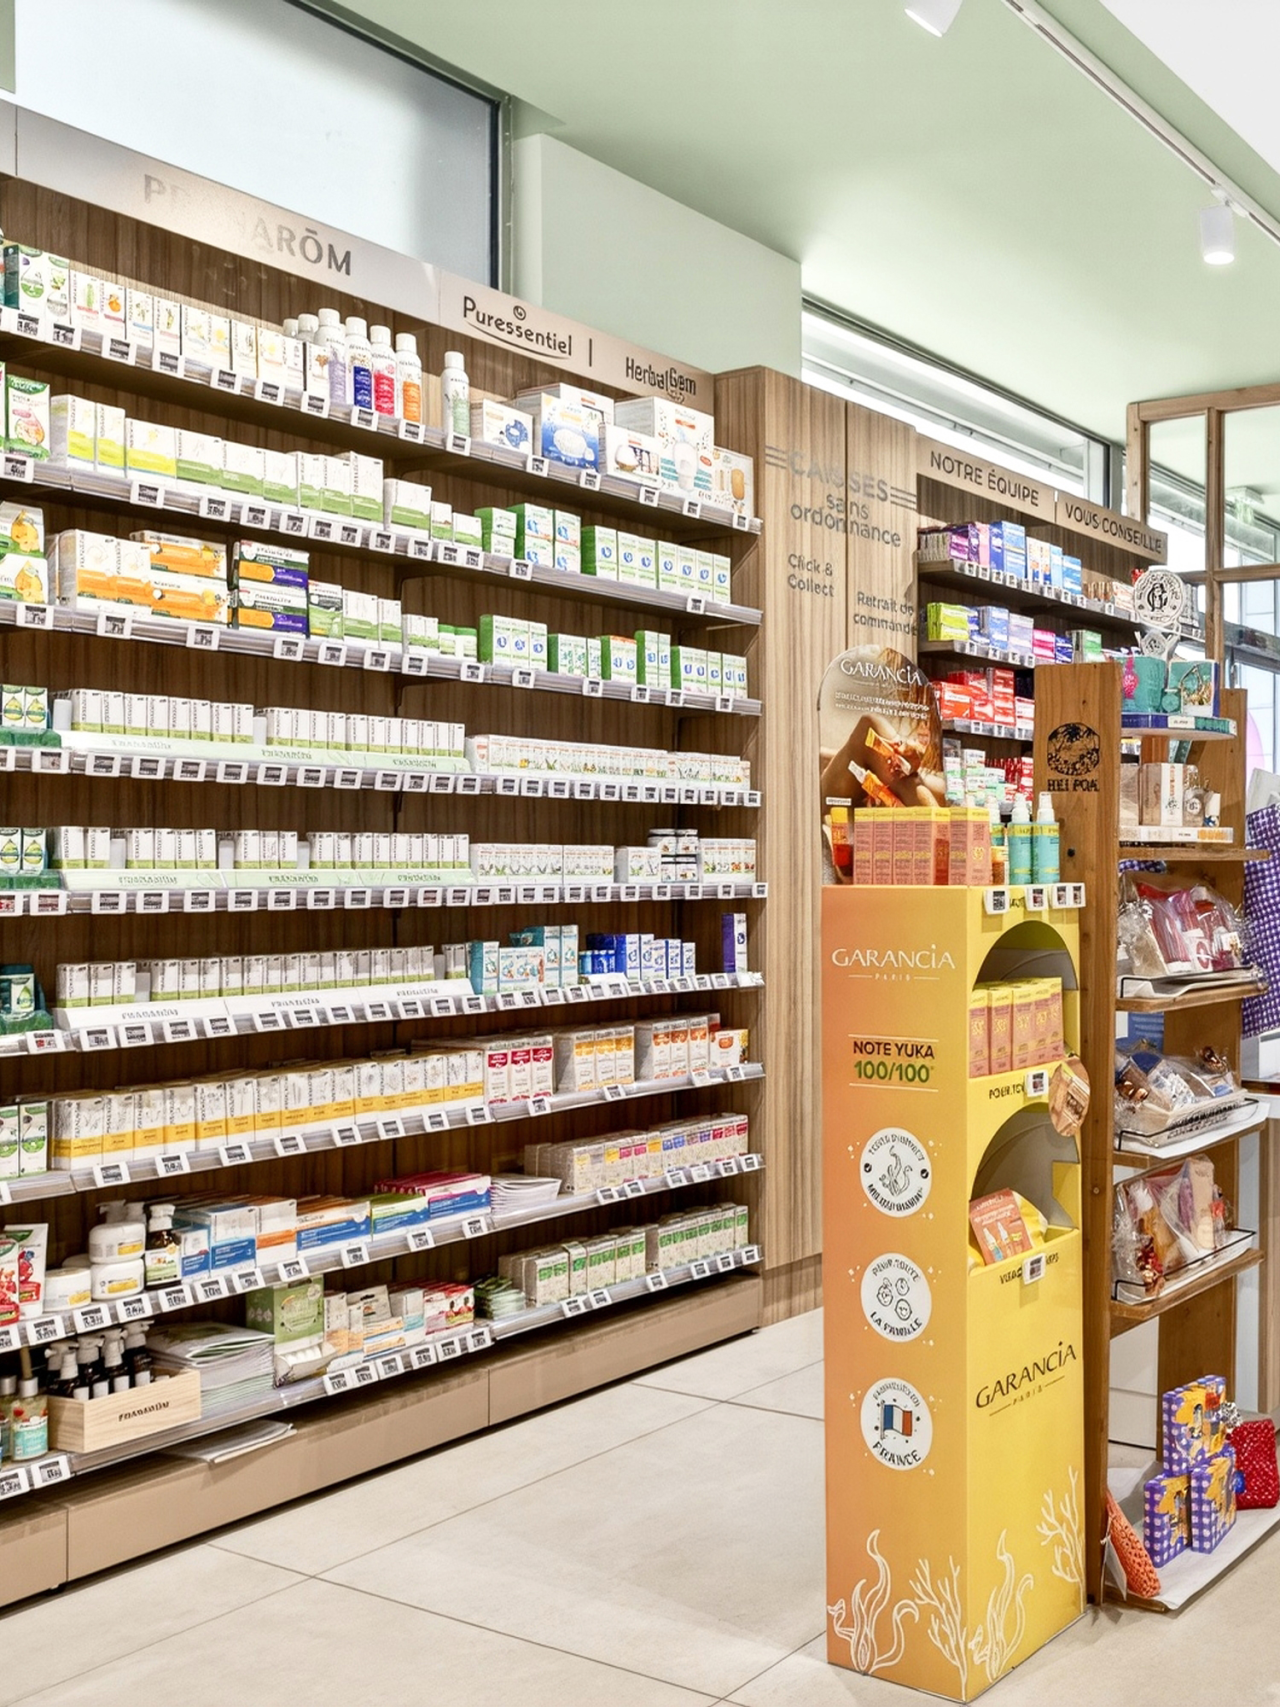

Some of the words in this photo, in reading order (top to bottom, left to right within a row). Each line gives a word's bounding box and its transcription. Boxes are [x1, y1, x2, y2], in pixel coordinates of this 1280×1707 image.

[463, 295, 572, 356] Puressentiel
[625, 356, 697, 396] HerbalGem
[788, 451, 890, 502] CAISSES
[930, 450, 983, 486] NOTRE
[988, 468, 1039, 507] ÉQUIPE
[826, 493, 870, 521] sans
[790, 503, 902, 548] ordonnance
[1066, 502, 1099, 530] VOUS
[1102, 517, 1162, 554] CONSEILLE
[788, 553, 821, 575] Click
[824, 561, 833, 577] &
[787, 574, 835, 598] Collect
[857, 590, 898, 613] Retrait
[900, 600, 914, 617] de
[853, 611, 918, 637] commande
[1047, 778, 1069, 792] HEI
[1073, 778, 1099, 792] POA
[853, 1041, 892, 1056] NOTE
[894, 1043, 935, 1060] YUKA
[854, 1060, 931, 1083] 100/100
[872, 1440, 922, 1467] FRANCE
